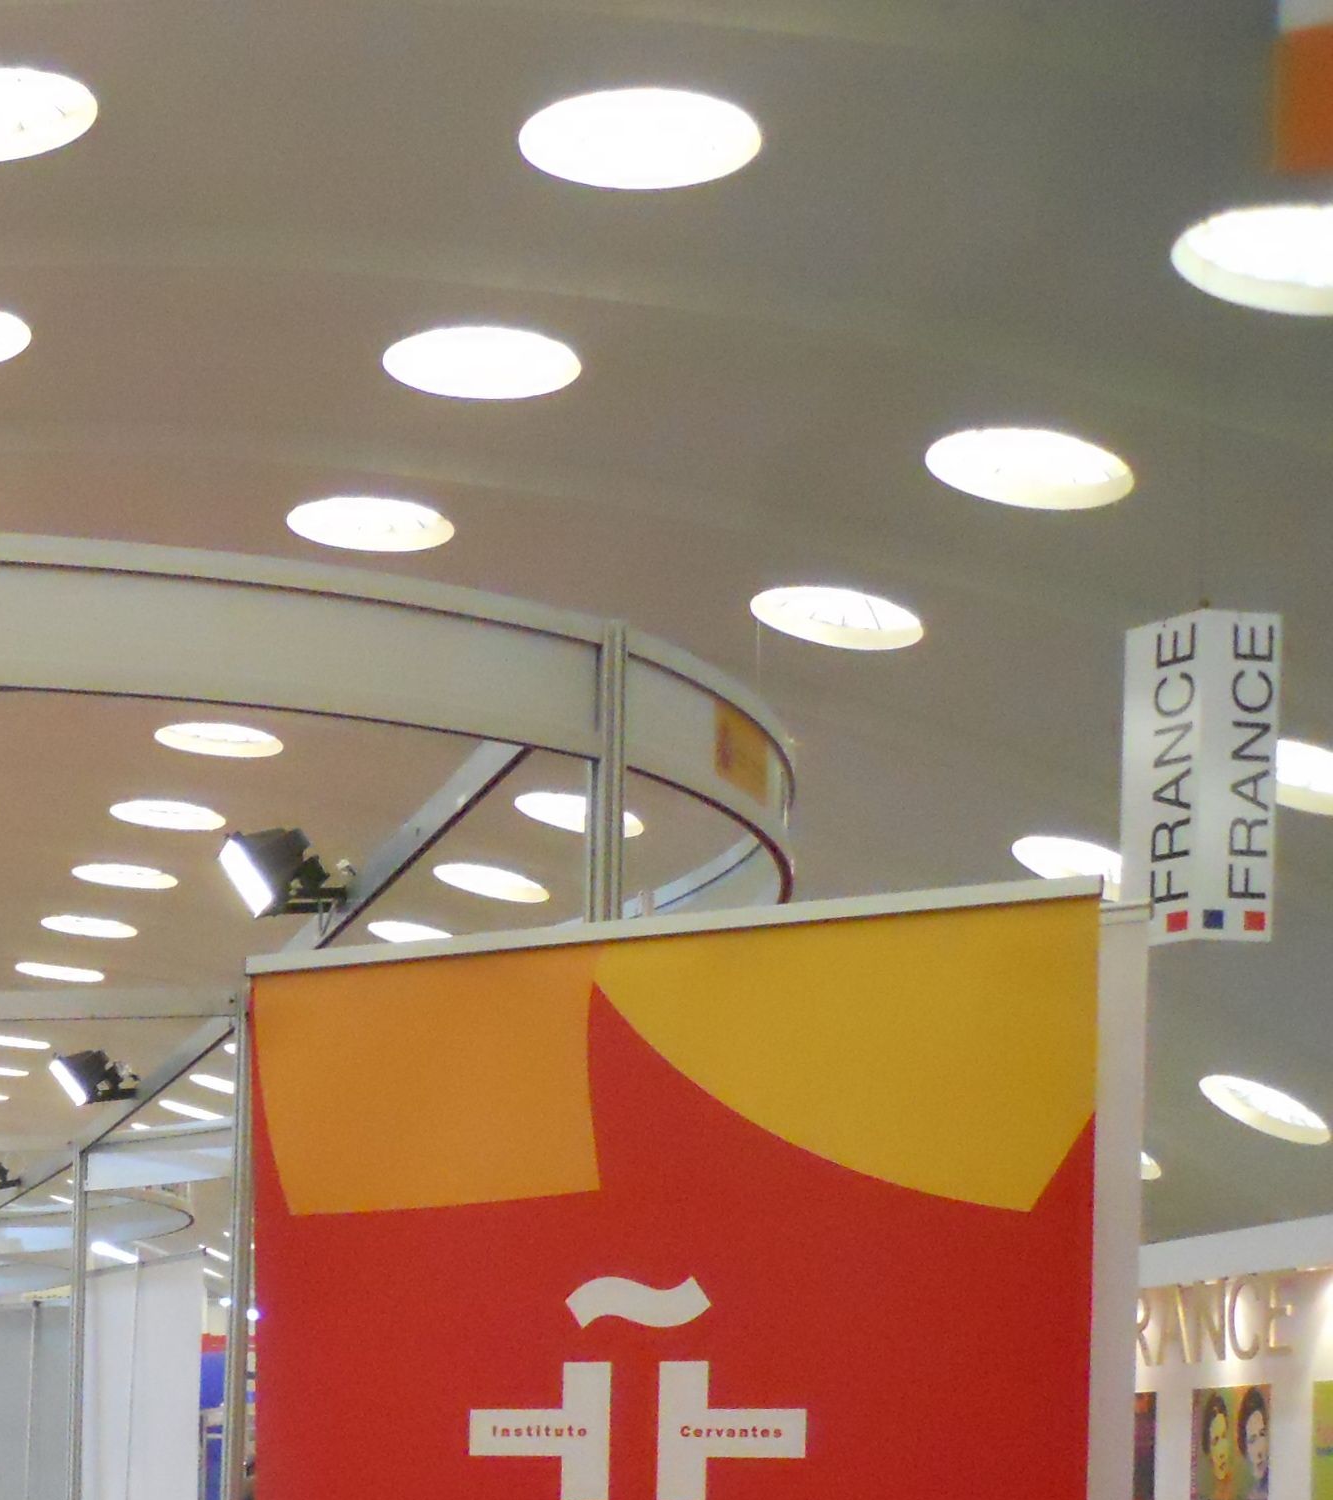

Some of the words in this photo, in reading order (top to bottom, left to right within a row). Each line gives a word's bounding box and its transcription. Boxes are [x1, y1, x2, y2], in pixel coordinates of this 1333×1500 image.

[1150, 623, 1196, 904] FRANCE
[1228, 624, 1274, 899] FRANCE
[1136, 1275, 1293, 1367] RANCE
[492, 1426, 588, 1438] Instituto
[680, 1425, 783, 1439] Cervantes
